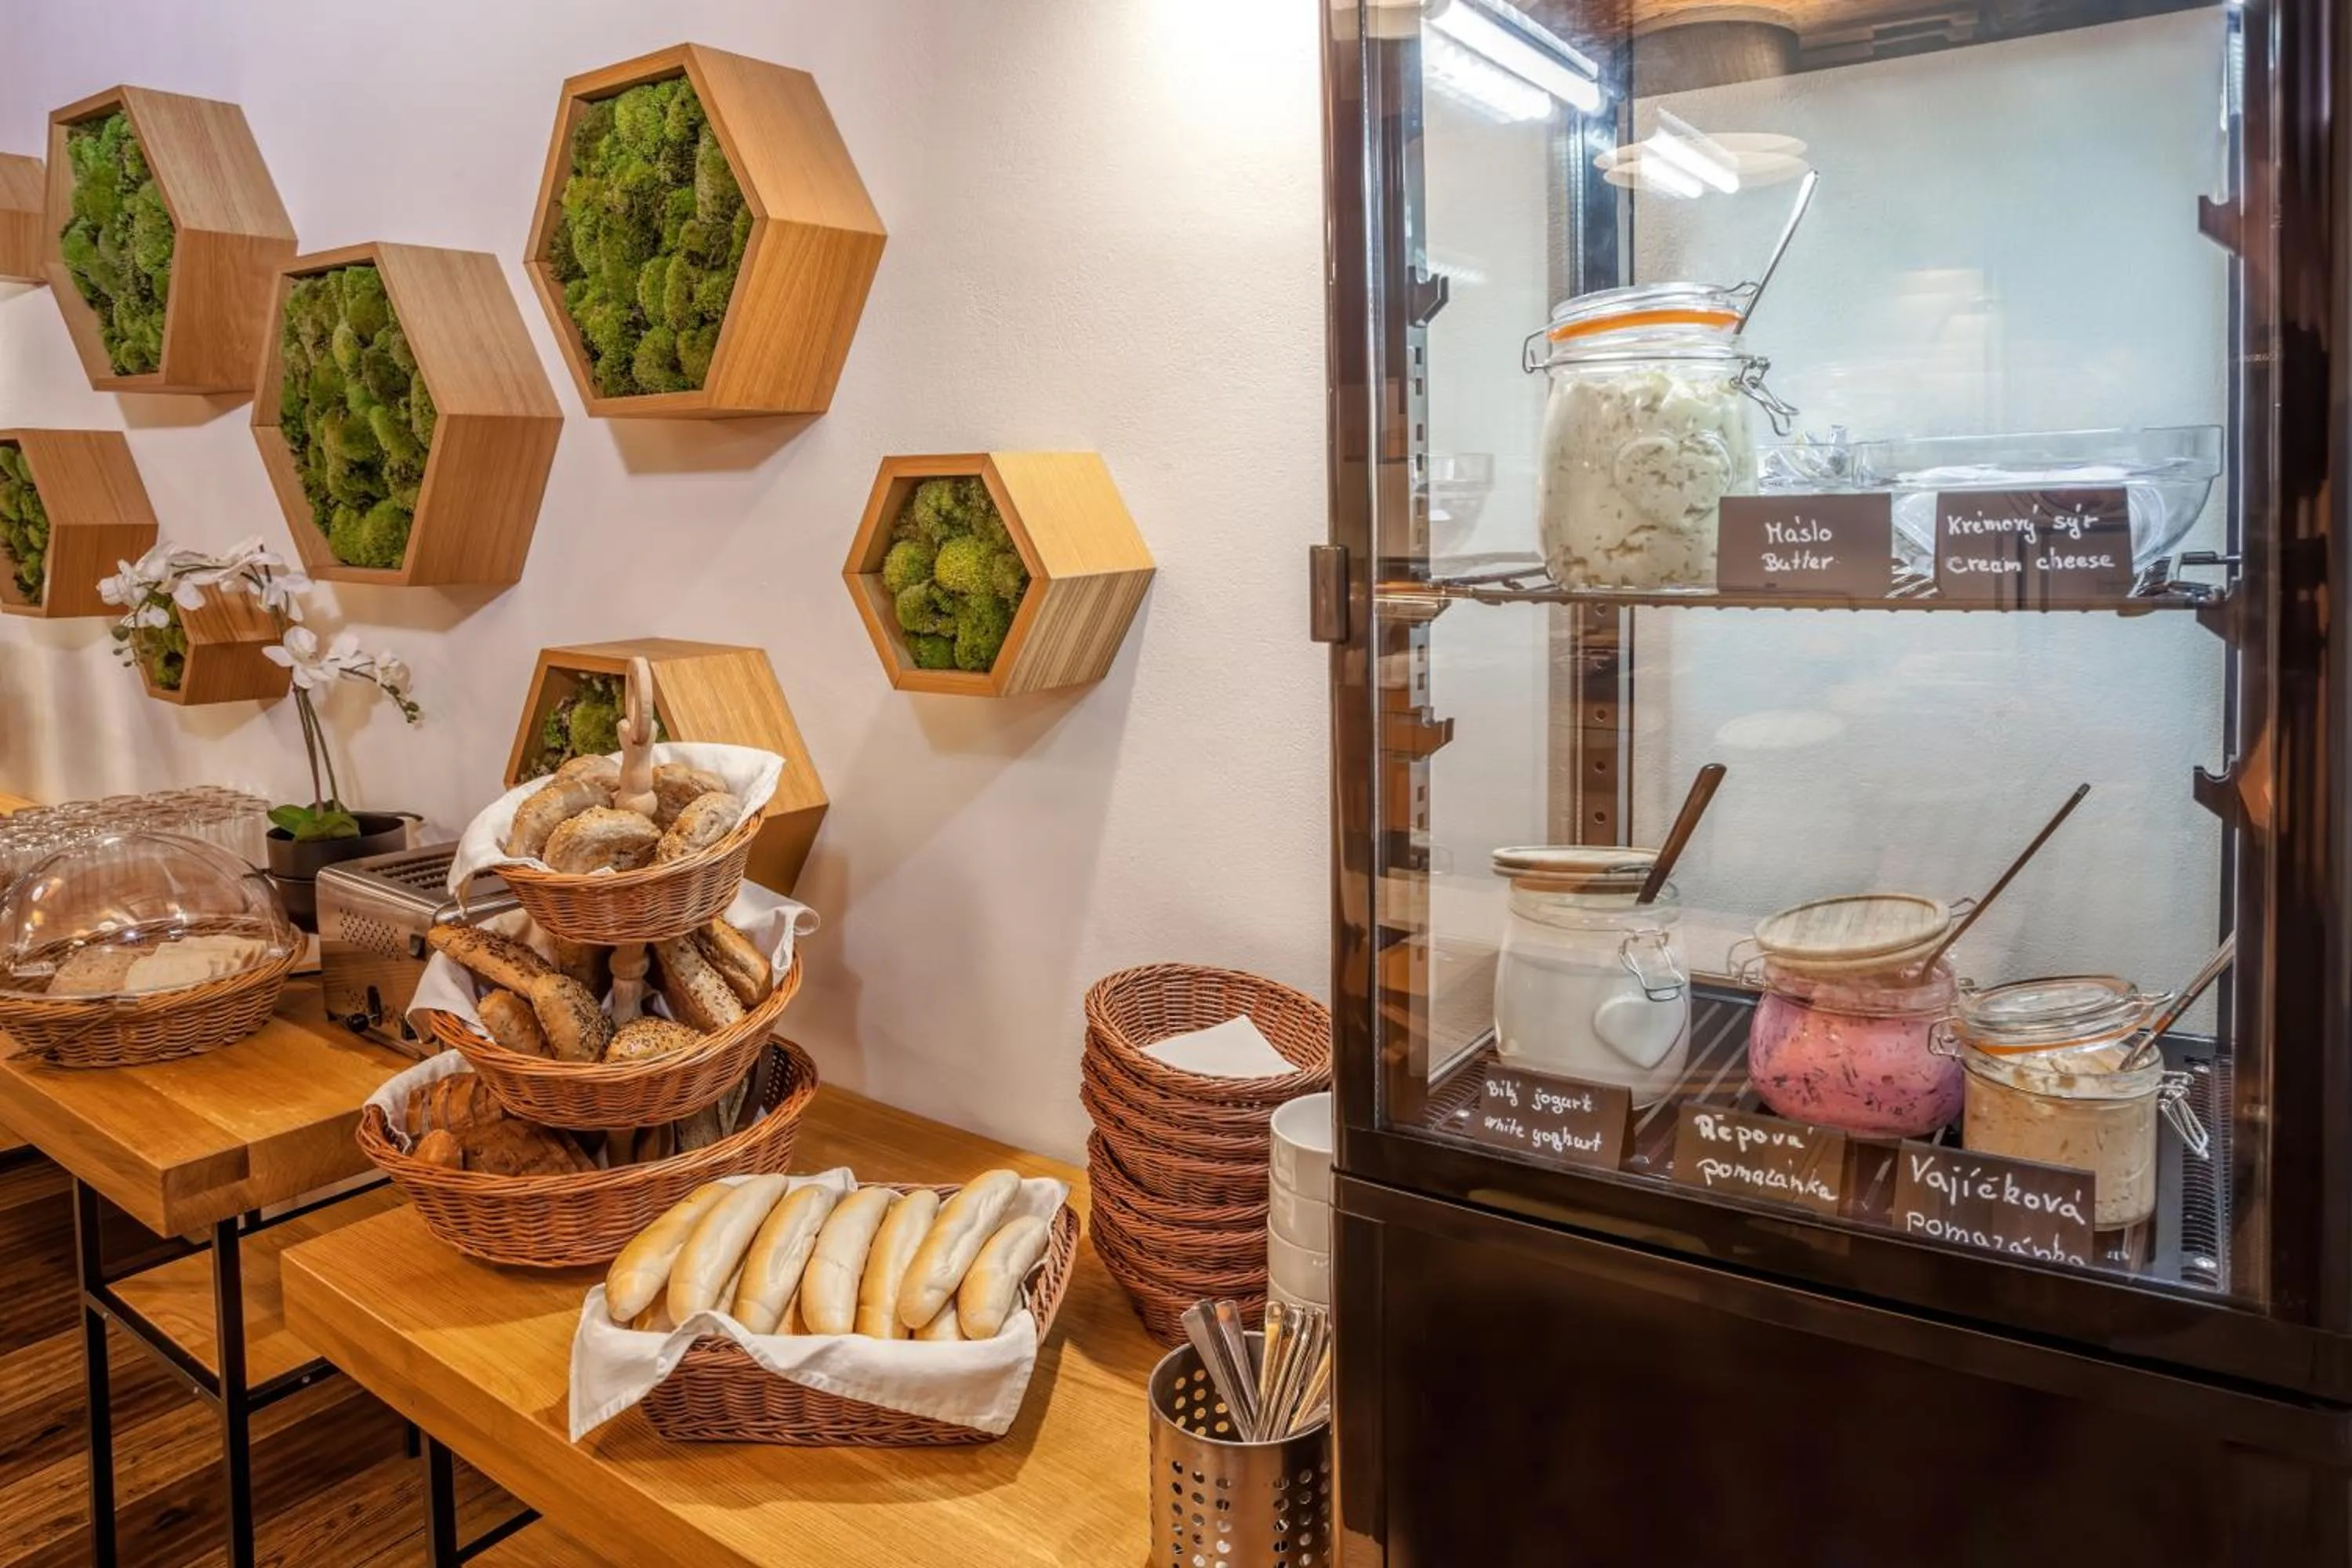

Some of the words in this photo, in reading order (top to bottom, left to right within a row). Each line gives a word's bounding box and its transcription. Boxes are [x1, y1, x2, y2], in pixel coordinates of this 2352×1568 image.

[1765, 515, 1832, 545] Máslo
[2053, 503, 2099, 540] sýr
[1761, 550, 1834, 572] Butter
[2036, 546, 2115, 570] cheese
[1531, 1087, 1593, 1114] jogurt
[1532, 1126, 1602, 1152] yoghurt
[1911, 1155, 2085, 1225] Vajíčková
